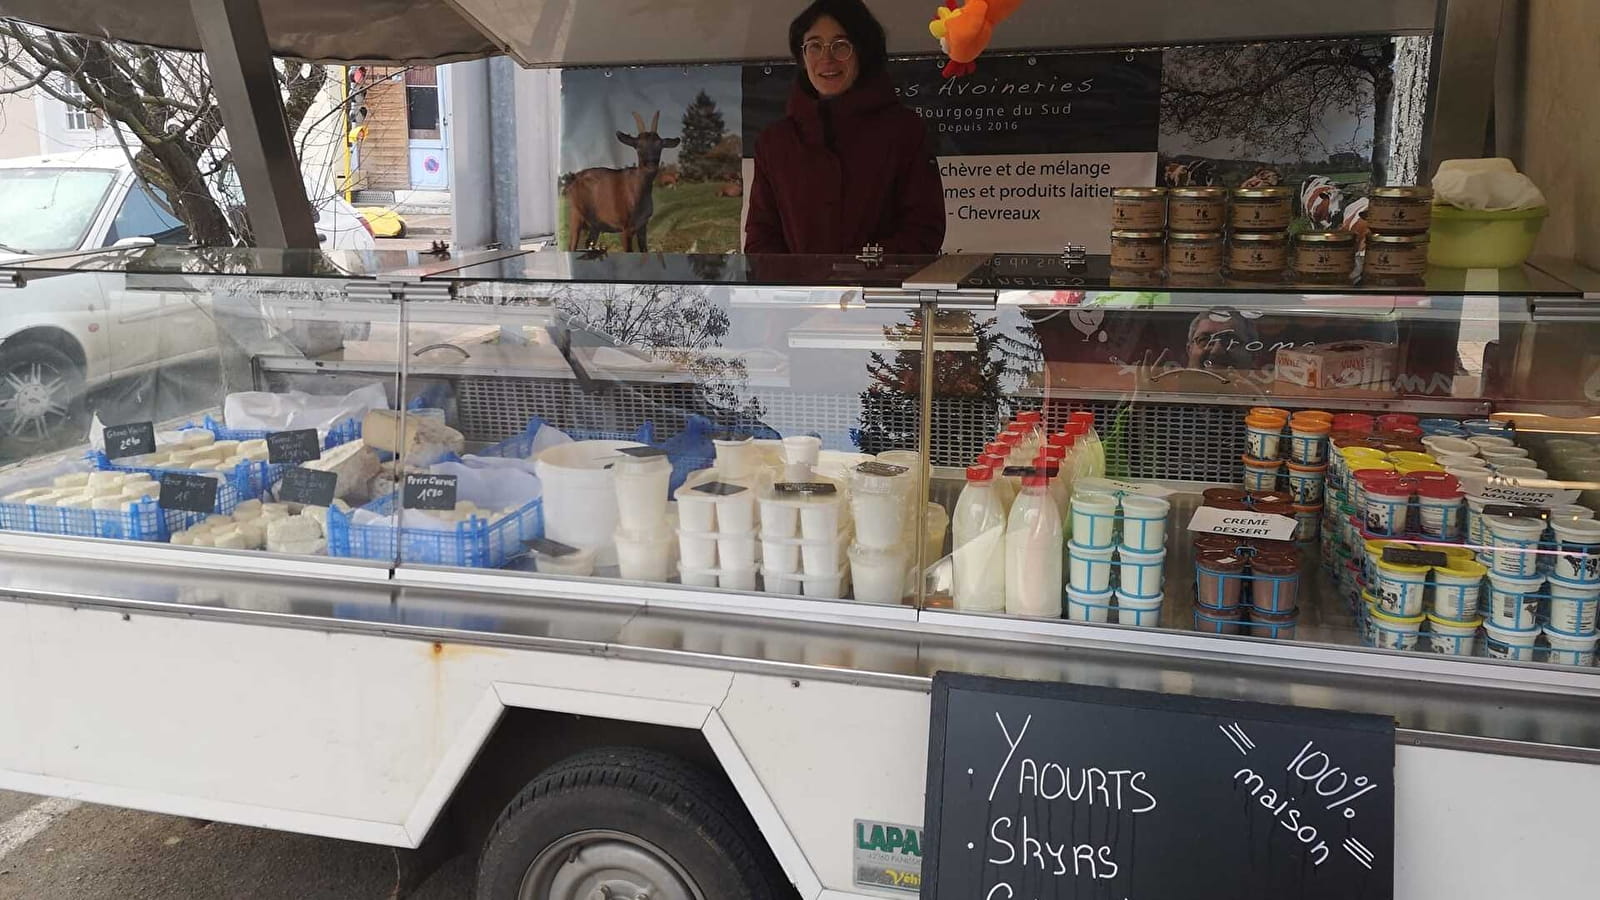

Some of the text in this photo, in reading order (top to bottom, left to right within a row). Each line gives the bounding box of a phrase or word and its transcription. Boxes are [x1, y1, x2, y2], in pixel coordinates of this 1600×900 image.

[893, 75, 1094, 97] es Avoineries
[915, 103, 1072, 120] Bourgogne du Sud
[939, 121, 1018, 133] Depuis 2016
[940, 160, 1111, 178] chèvre et de mélange
[944, 183, 1115, 200] mes et produits laitier
[958, 205, 1041, 220] Chevreaux
[1481, 492, 1546, 503] MAISON
[1484, 487, 1555, 498] YAOURTS
[1213, 525, 1271, 535] DESSERT
[1223, 517, 1270, 526] CREME
[989, 711, 1157, 813] YAOURTS
[1286, 740, 1378, 818] 100%
[1233, 768, 1330, 865] maison
[857, 822, 923, 857] LAPA
